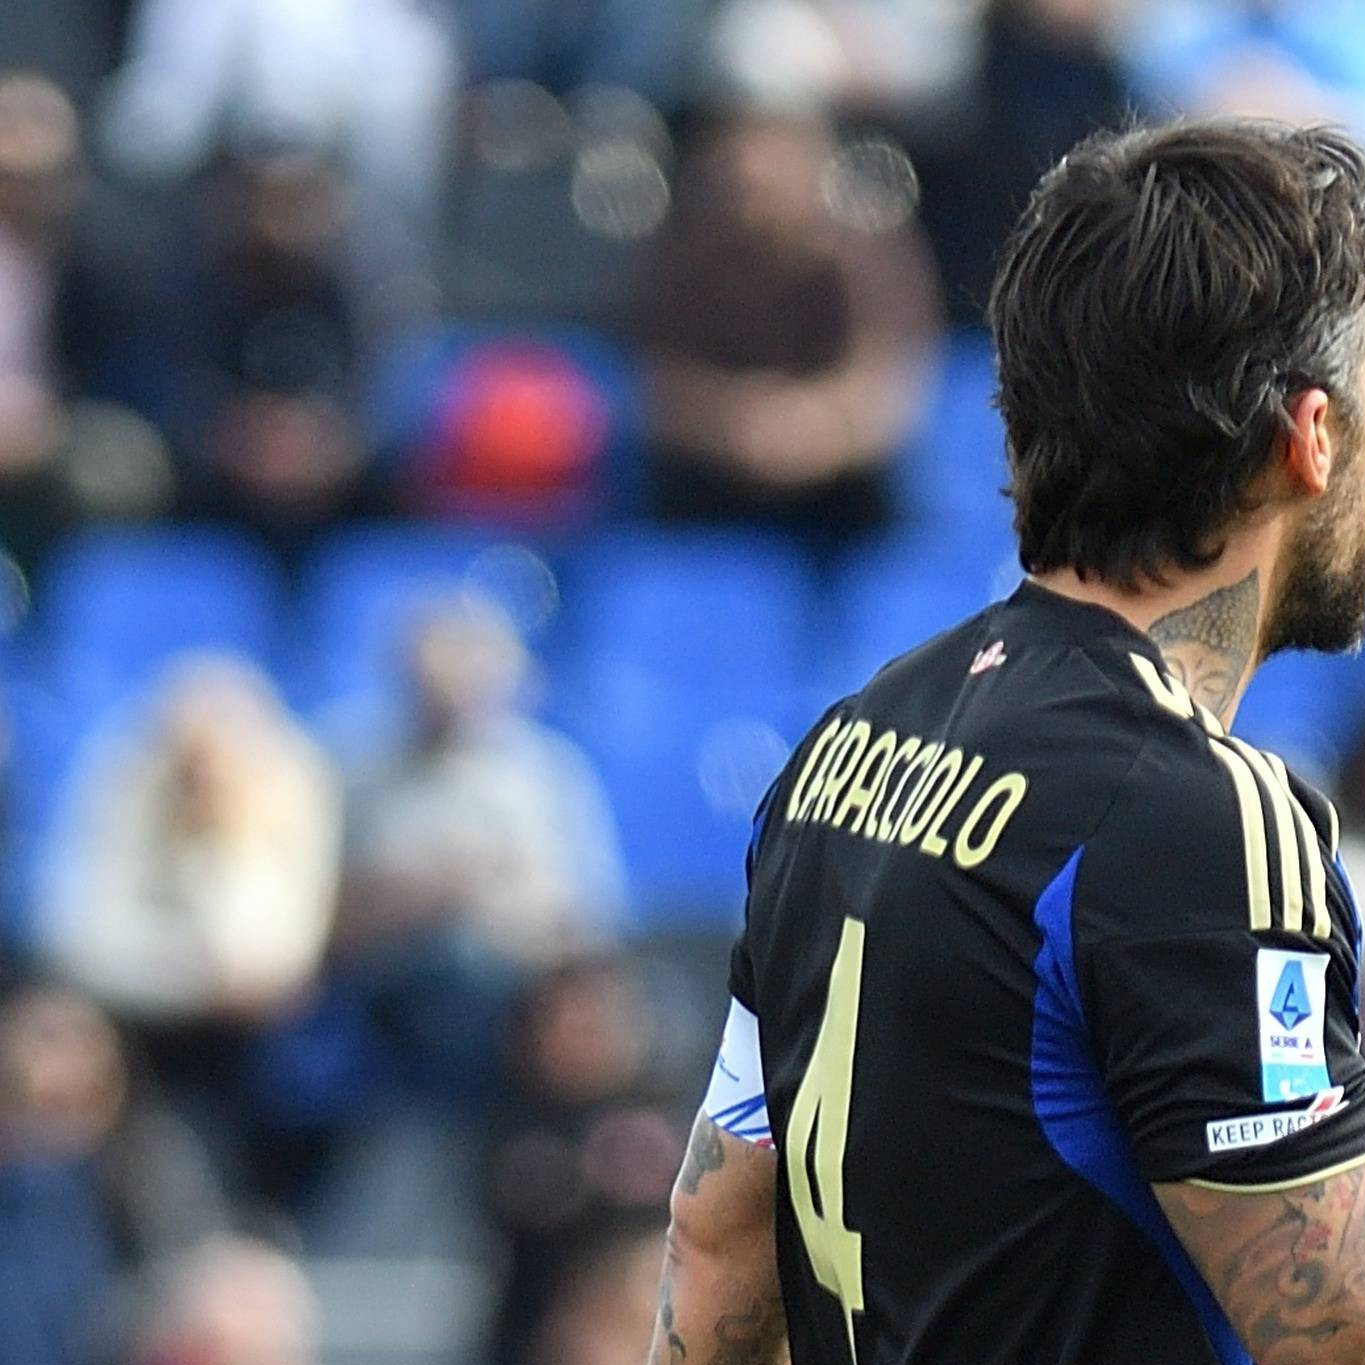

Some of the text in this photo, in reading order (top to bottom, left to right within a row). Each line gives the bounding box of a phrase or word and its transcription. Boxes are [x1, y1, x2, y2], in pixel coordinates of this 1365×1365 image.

[787, 716, 1028, 869] CARACCIOLO
[1270, 1035, 1313, 1049] SERIE A
[786, 915, 865, 1312] 4
[1212, 1122, 1264, 1146] KEEP
